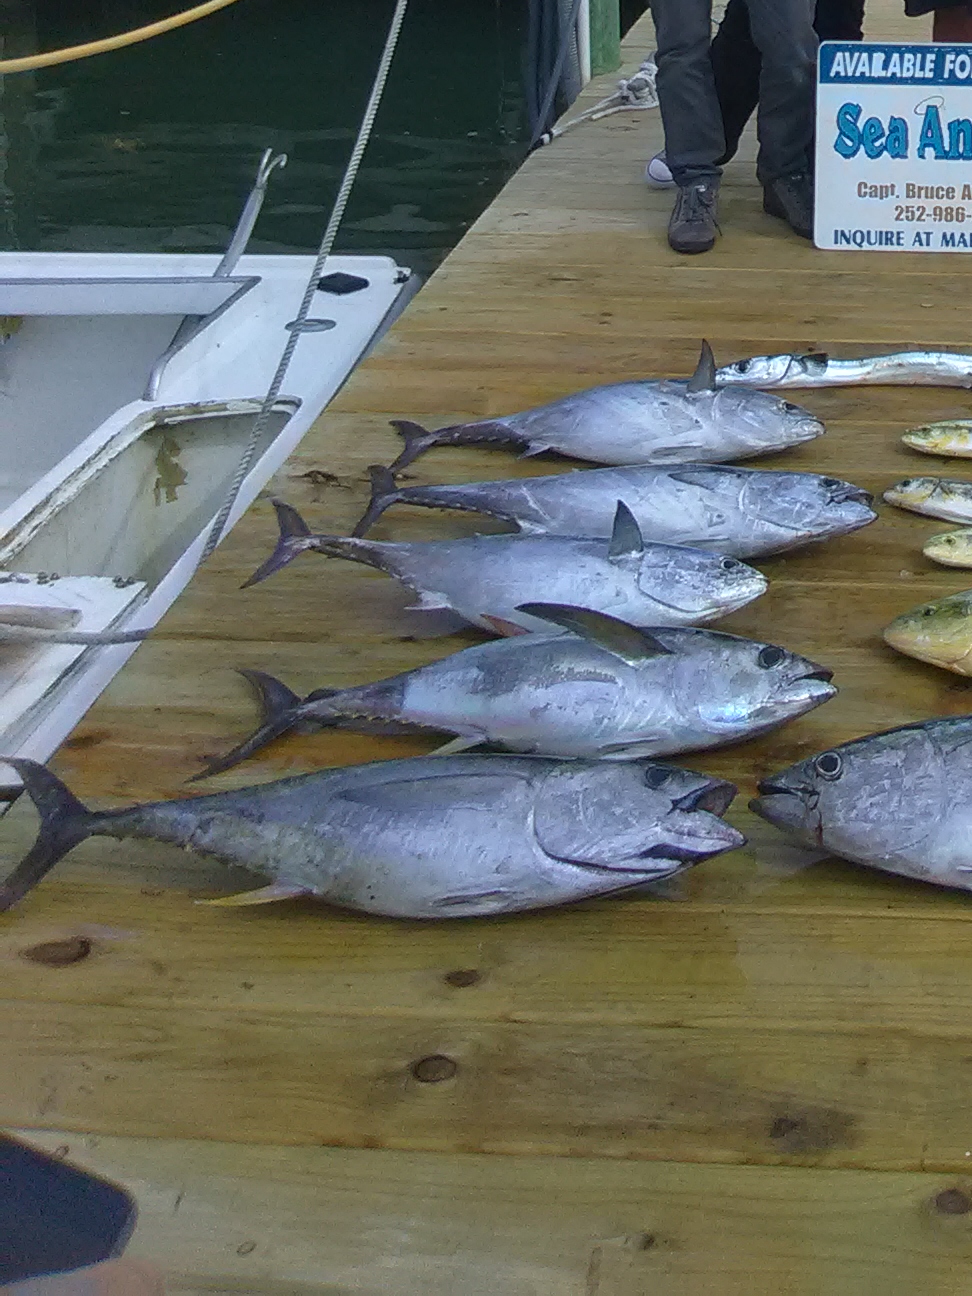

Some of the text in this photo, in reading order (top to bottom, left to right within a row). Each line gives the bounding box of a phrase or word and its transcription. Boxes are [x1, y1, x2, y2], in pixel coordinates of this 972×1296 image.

[833, 102, 909, 159] Sea
[857, 181, 900, 200] Capt.
[905, 183, 956, 201] Bruce
[833, 229, 904, 247] INQUIRE
[912, 231, 934, 247] AT
